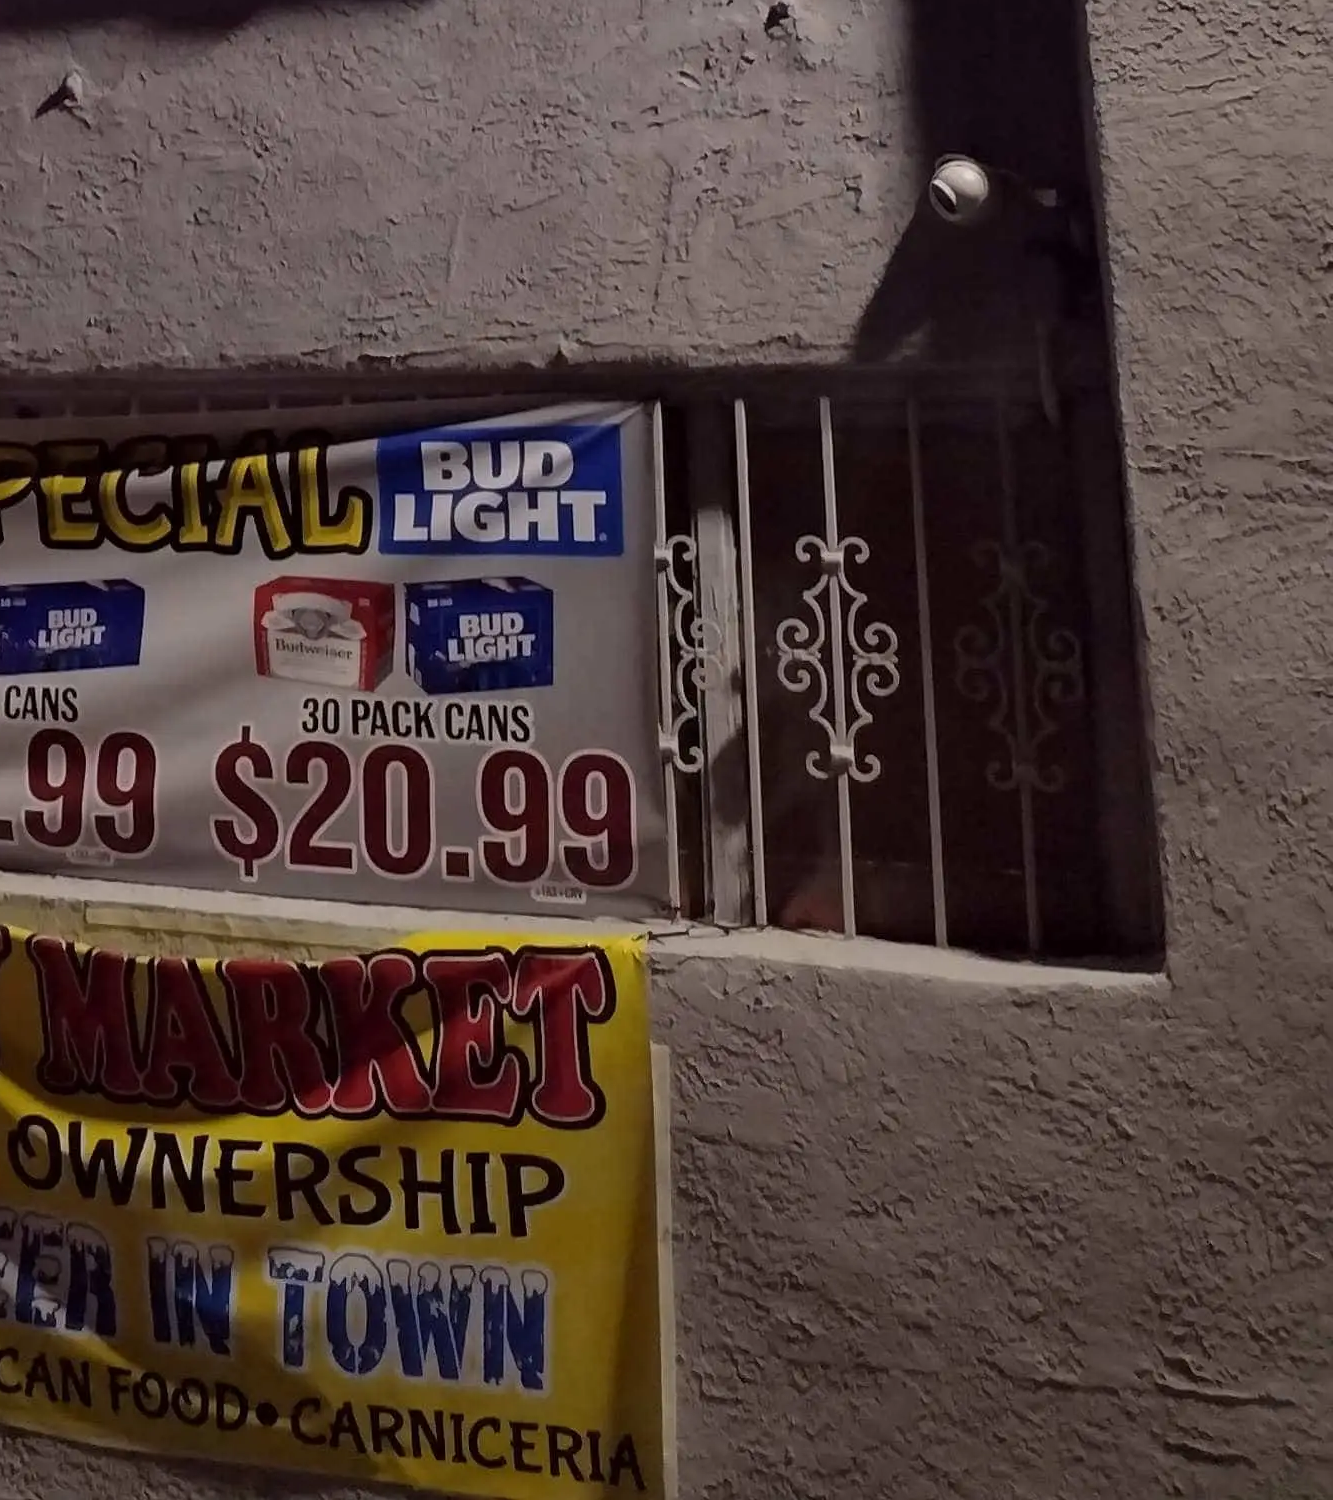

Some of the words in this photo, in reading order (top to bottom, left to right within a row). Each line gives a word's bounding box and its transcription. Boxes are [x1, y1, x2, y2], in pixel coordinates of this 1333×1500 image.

[421, 440, 574, 490] BUD
[394, 490, 607, 542] LIGHT
[37, 625, 106, 651] LIGHT
[48, 608, 98, 629] BUD
[459, 612, 524, 638] BUD
[447, 633, 537, 664] LIGHT
[5, 685, 79, 722] CANS
[302, 698, 340, 734] 30
[351, 699, 436, 739] PACK
[444, 703, 530, 743] CANS
[213, 726, 634, 887] $20.99
[28, 932, 617, 1130] MARKET
[7, 1113, 565, 1238] OWNERSHIP
[147, 1236, 233, 1356] IN
[267, 1248, 548, 1391] TOWN
[109, 1366, 249, 1431] FOOD
[290, 1397, 647, 1490] CARNICERIA
